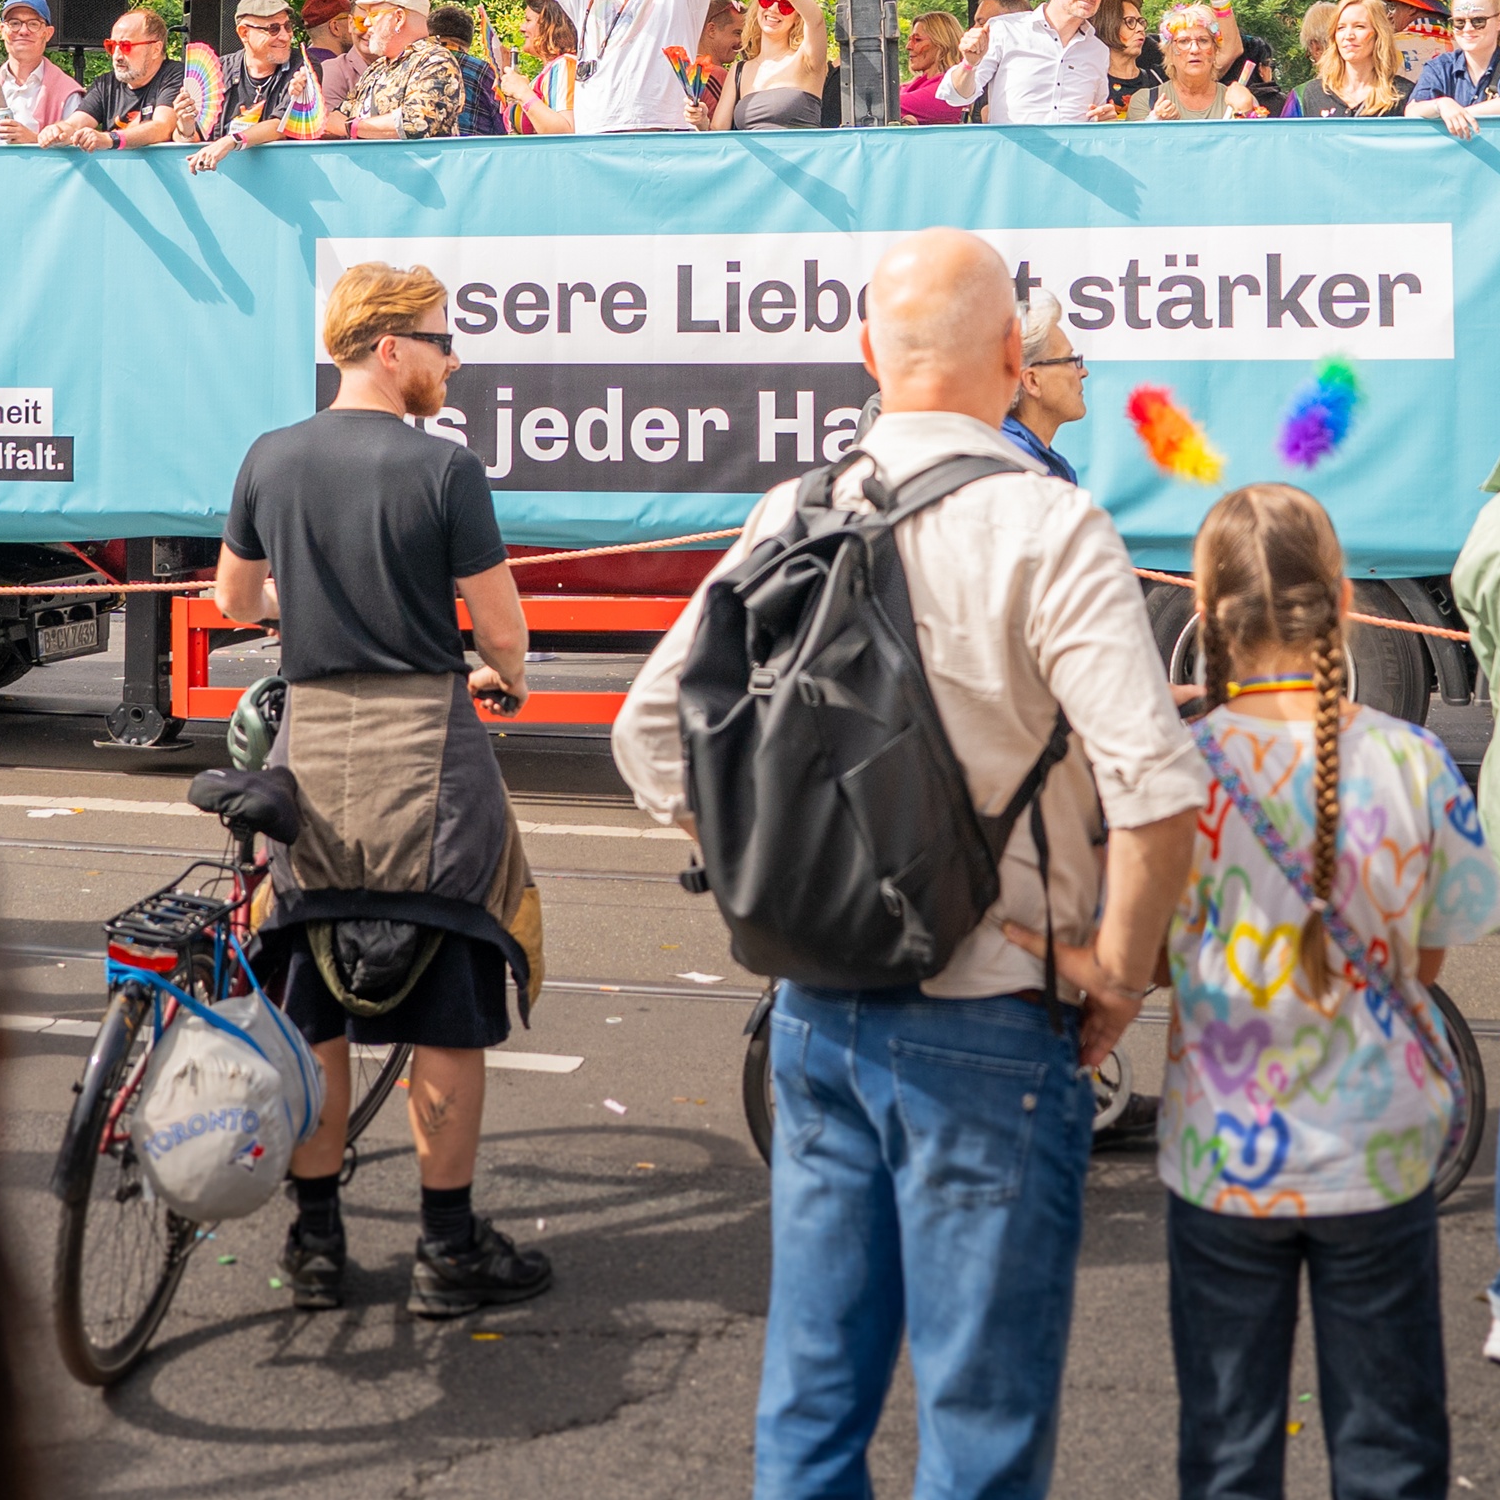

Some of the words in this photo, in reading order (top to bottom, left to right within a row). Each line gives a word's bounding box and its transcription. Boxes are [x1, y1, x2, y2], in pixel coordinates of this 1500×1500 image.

[1067, 253, 1422, 330] stärker
[486, 387, 730, 478] jeder
[758, 390, 863, 463] Ha
[143, 1106, 260, 1161] TORONTO
